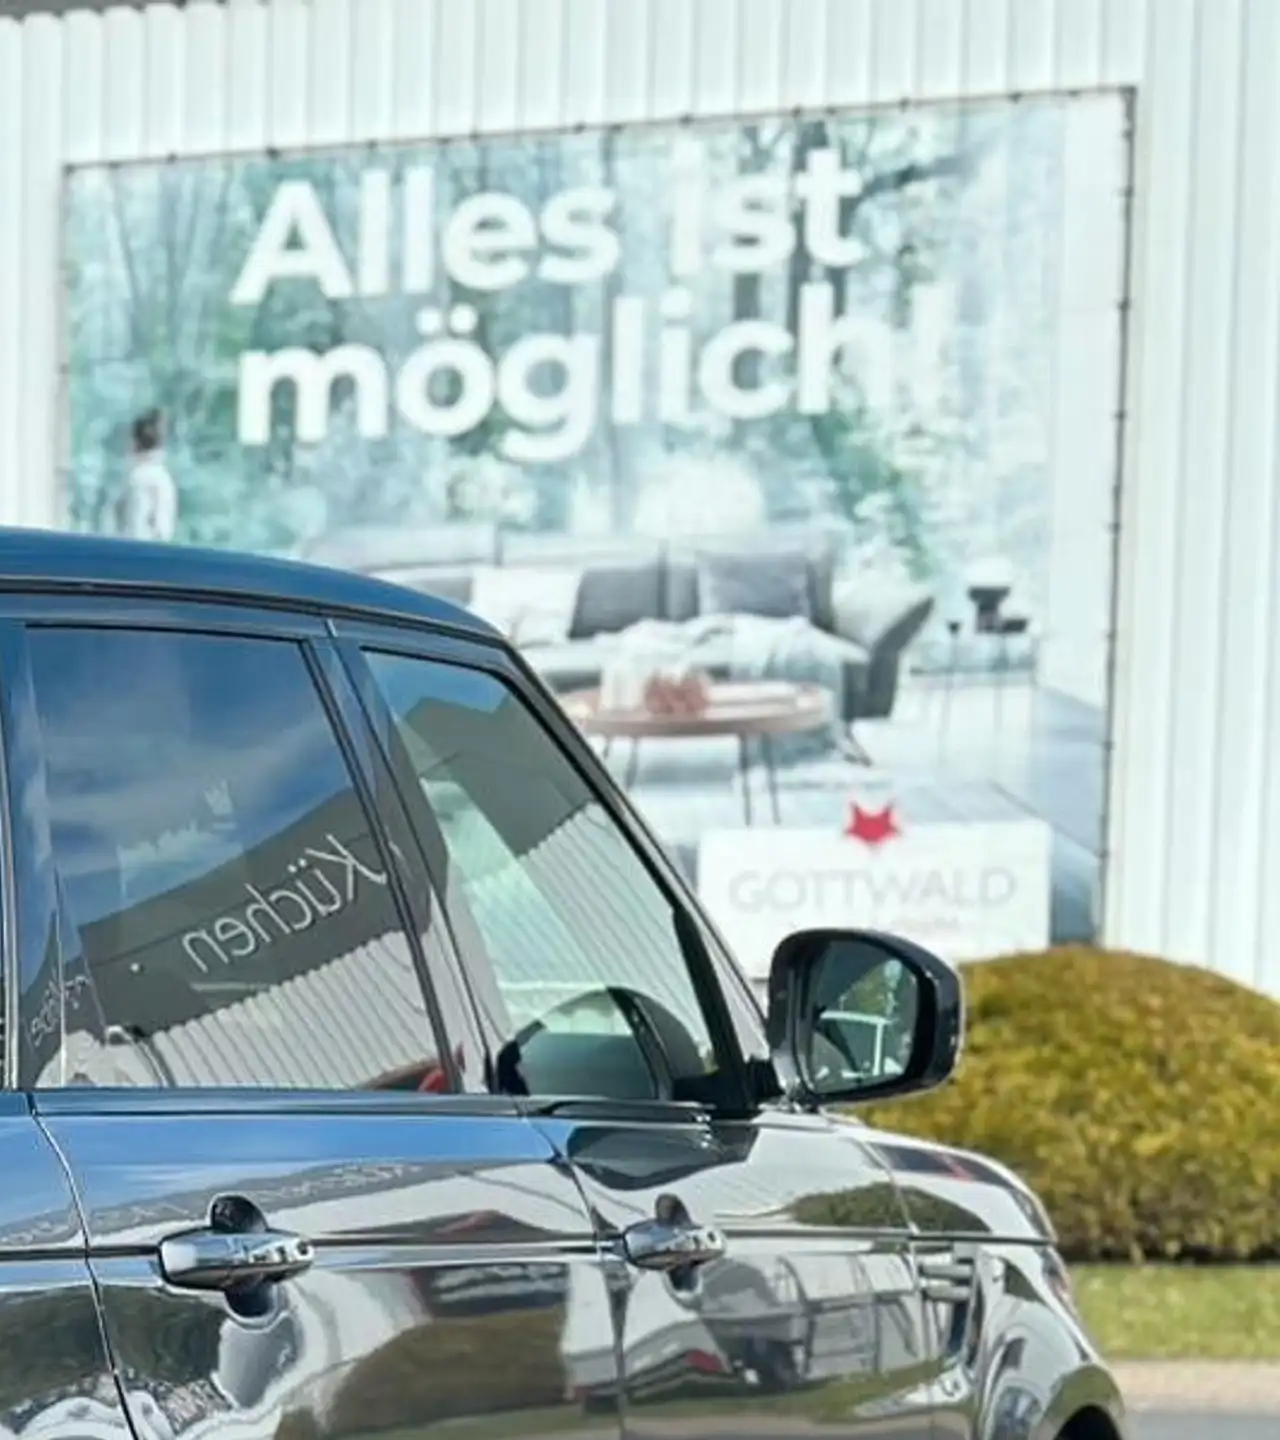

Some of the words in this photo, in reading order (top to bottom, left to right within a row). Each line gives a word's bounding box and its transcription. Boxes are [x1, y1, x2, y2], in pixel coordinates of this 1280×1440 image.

[232, 171, 621, 302] Alles
[670, 144, 862, 275] ist
[727, 864, 1018, 914] GOTTWALD
